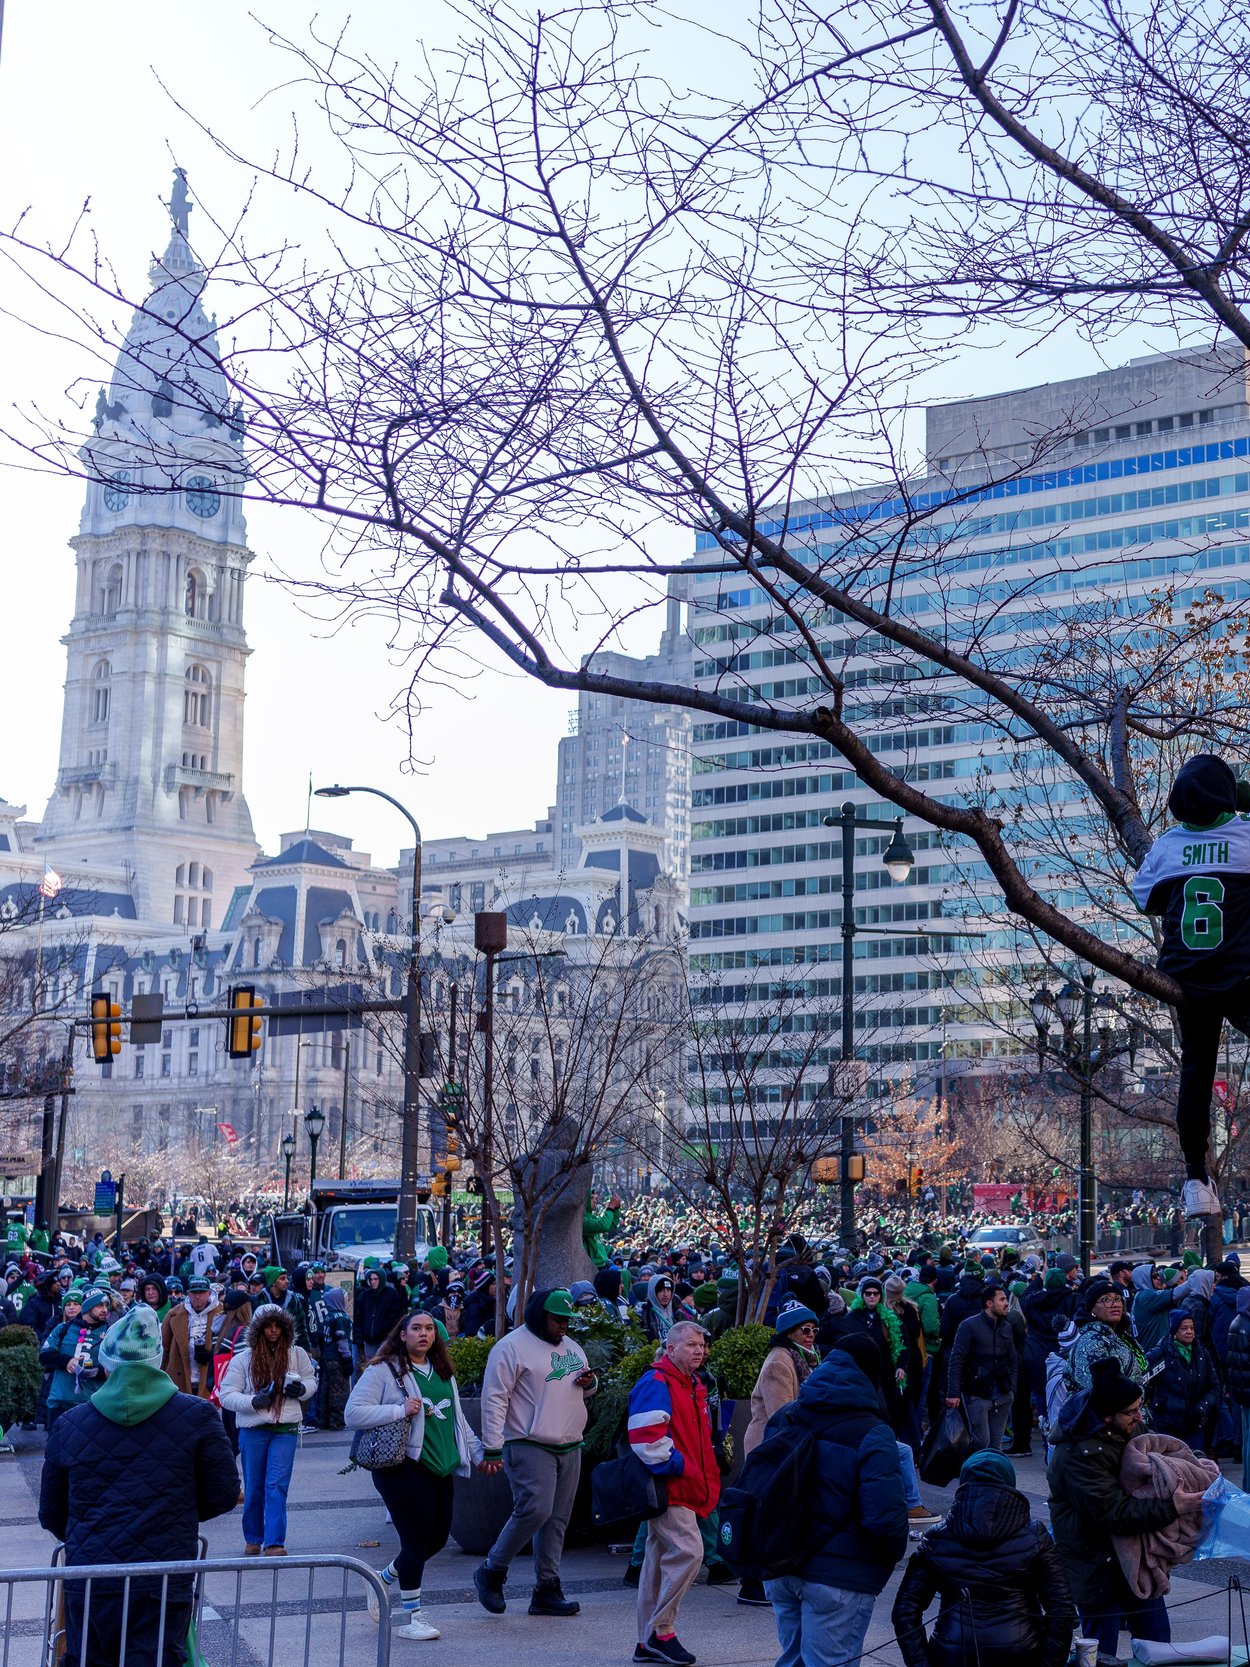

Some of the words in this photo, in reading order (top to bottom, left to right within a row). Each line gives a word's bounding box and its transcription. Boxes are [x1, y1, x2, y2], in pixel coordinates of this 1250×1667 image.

[1182, 841, 1229, 865] SMITH
[1181, 876, 1225, 950] 6
[551, 1349, 585, 1370] Eagles
